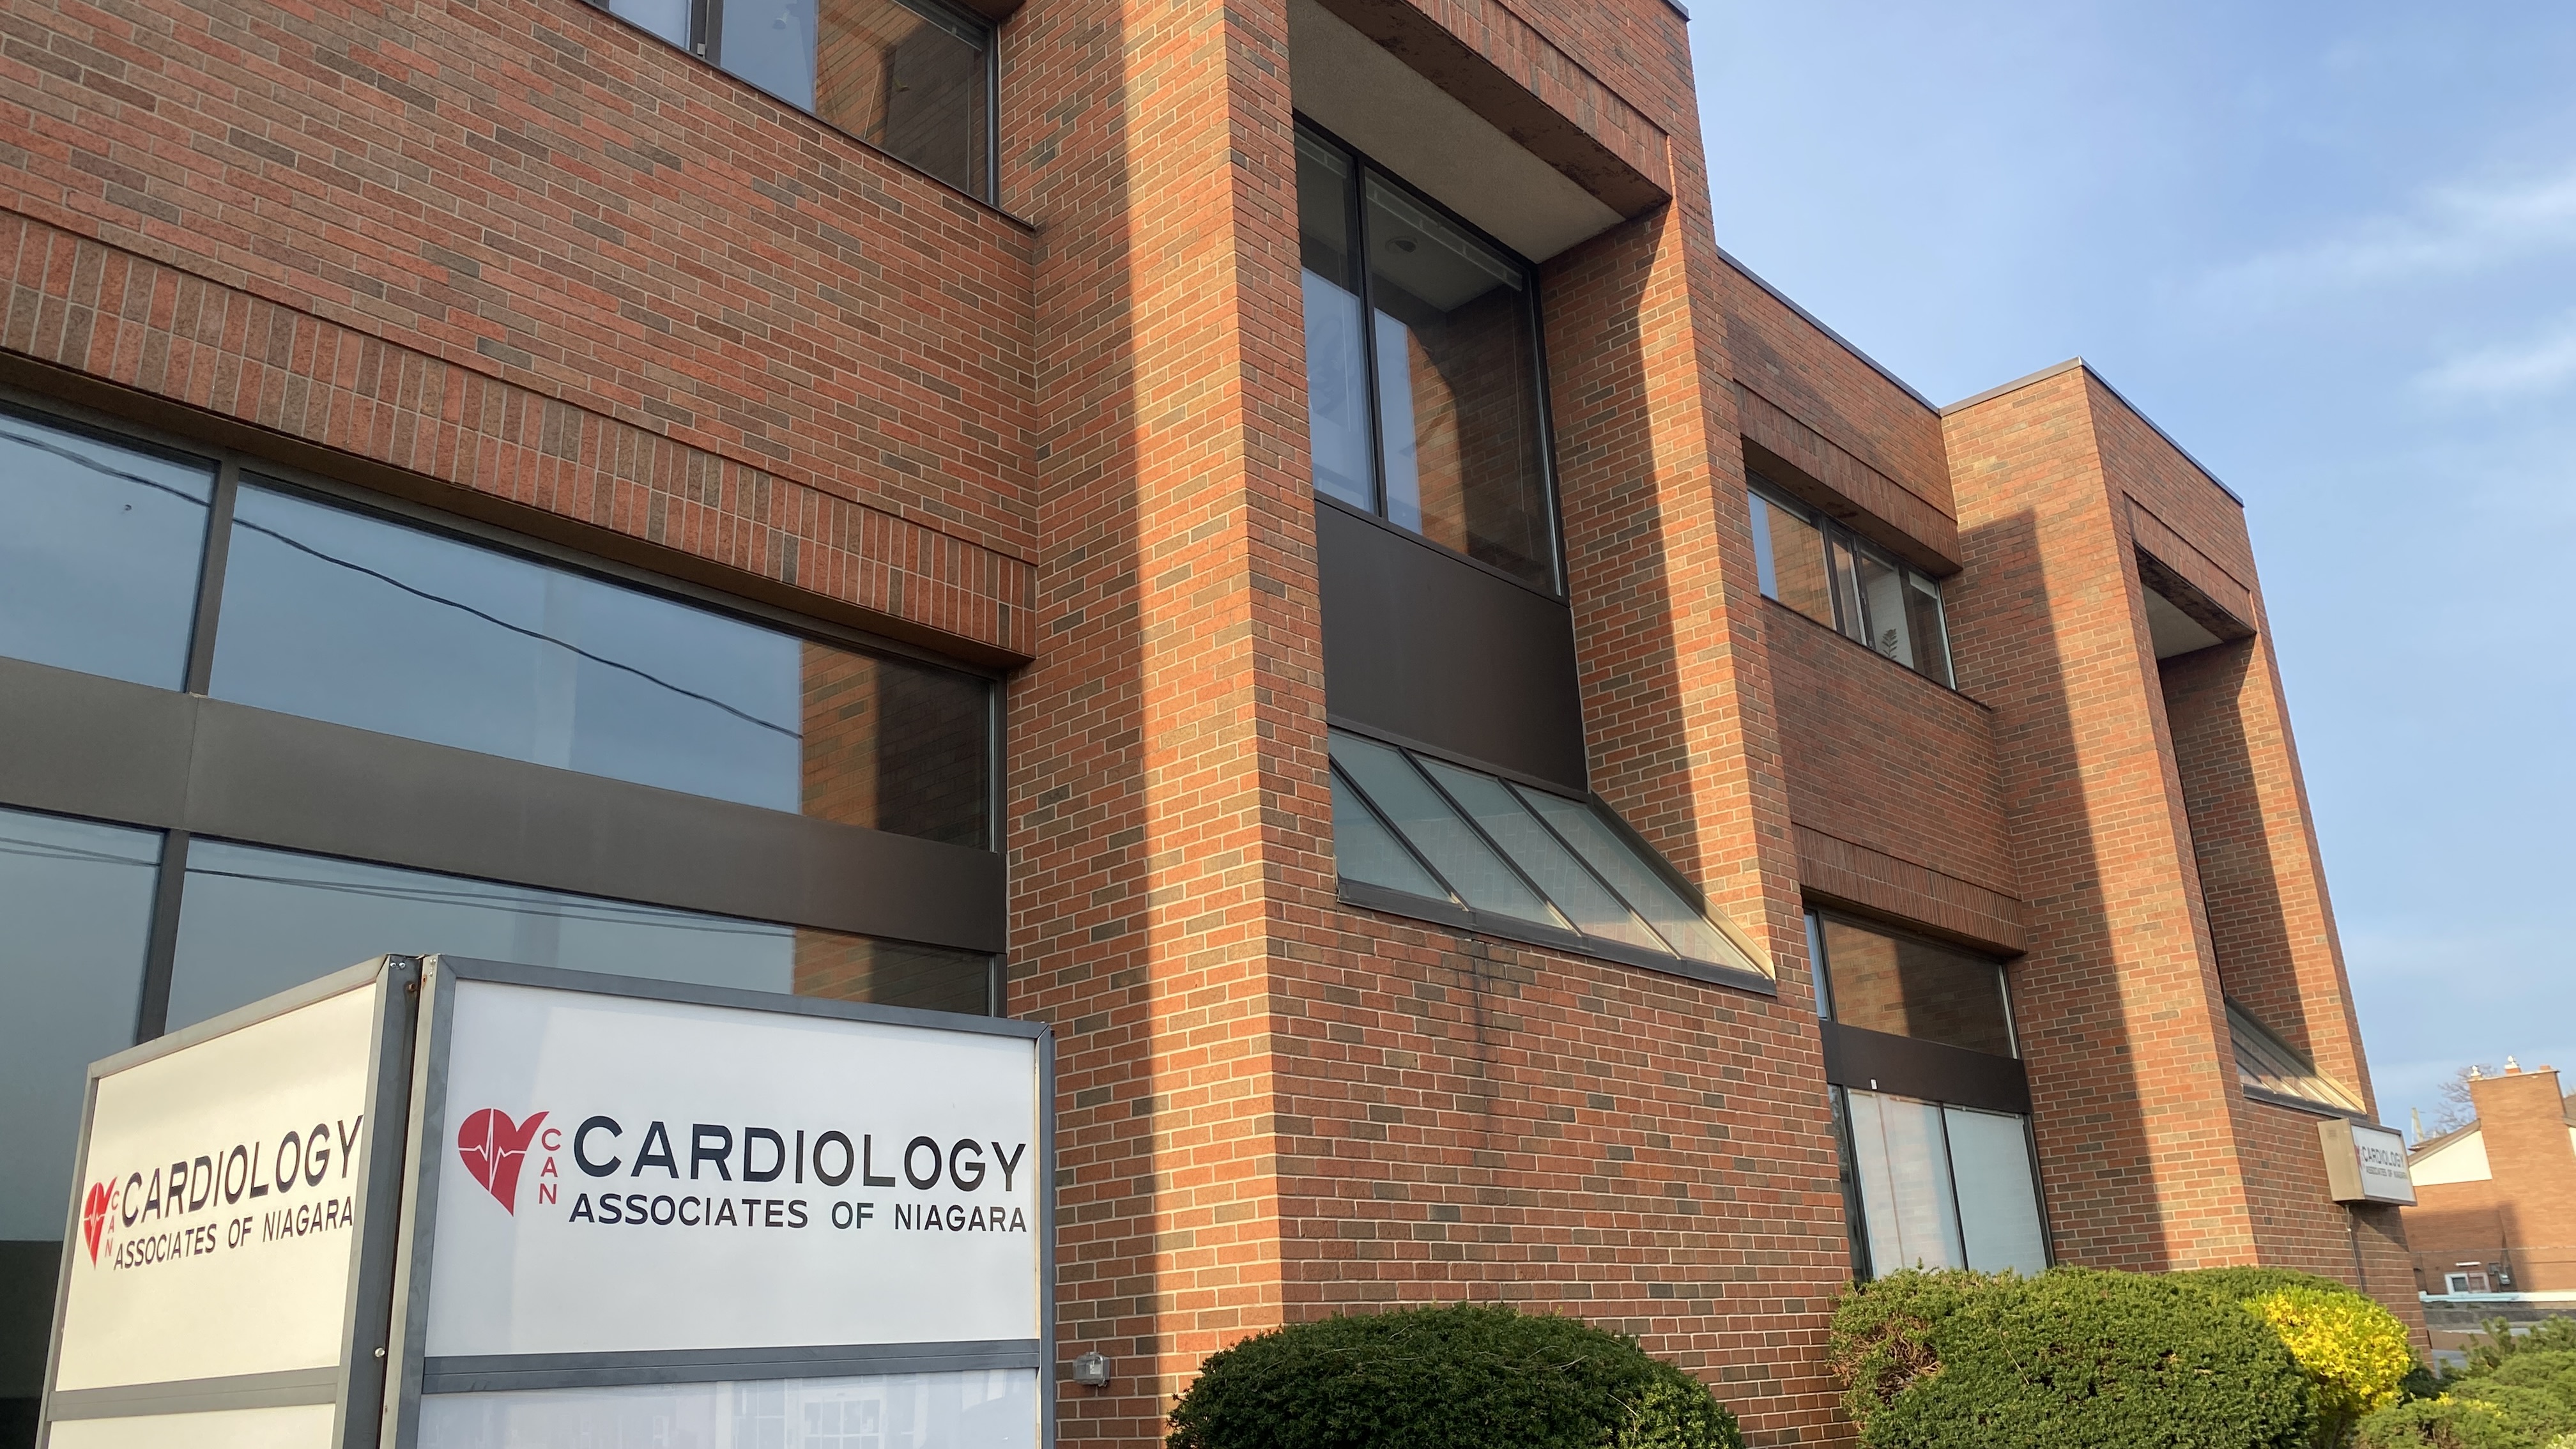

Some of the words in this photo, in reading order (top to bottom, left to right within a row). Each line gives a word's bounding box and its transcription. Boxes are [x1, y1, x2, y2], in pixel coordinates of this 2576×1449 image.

[121, 1114, 364, 1227] CARDIOLOGY
[538, 1127, 562, 1206] CAN
[573, 1116, 1027, 1193] CARDIOLOGY
[105, 1190, 120, 1257] CAN
[114, 1223, 217, 1269] ASSOCIATES
[227, 1216, 253, 1249] OF
[263, 1195, 353, 1243] NIAGARA
[568, 1192, 809, 1229] ASSOCIATES
[831, 1201, 875, 1230] OF
[894, 1204, 1027, 1233] NIAGARA
